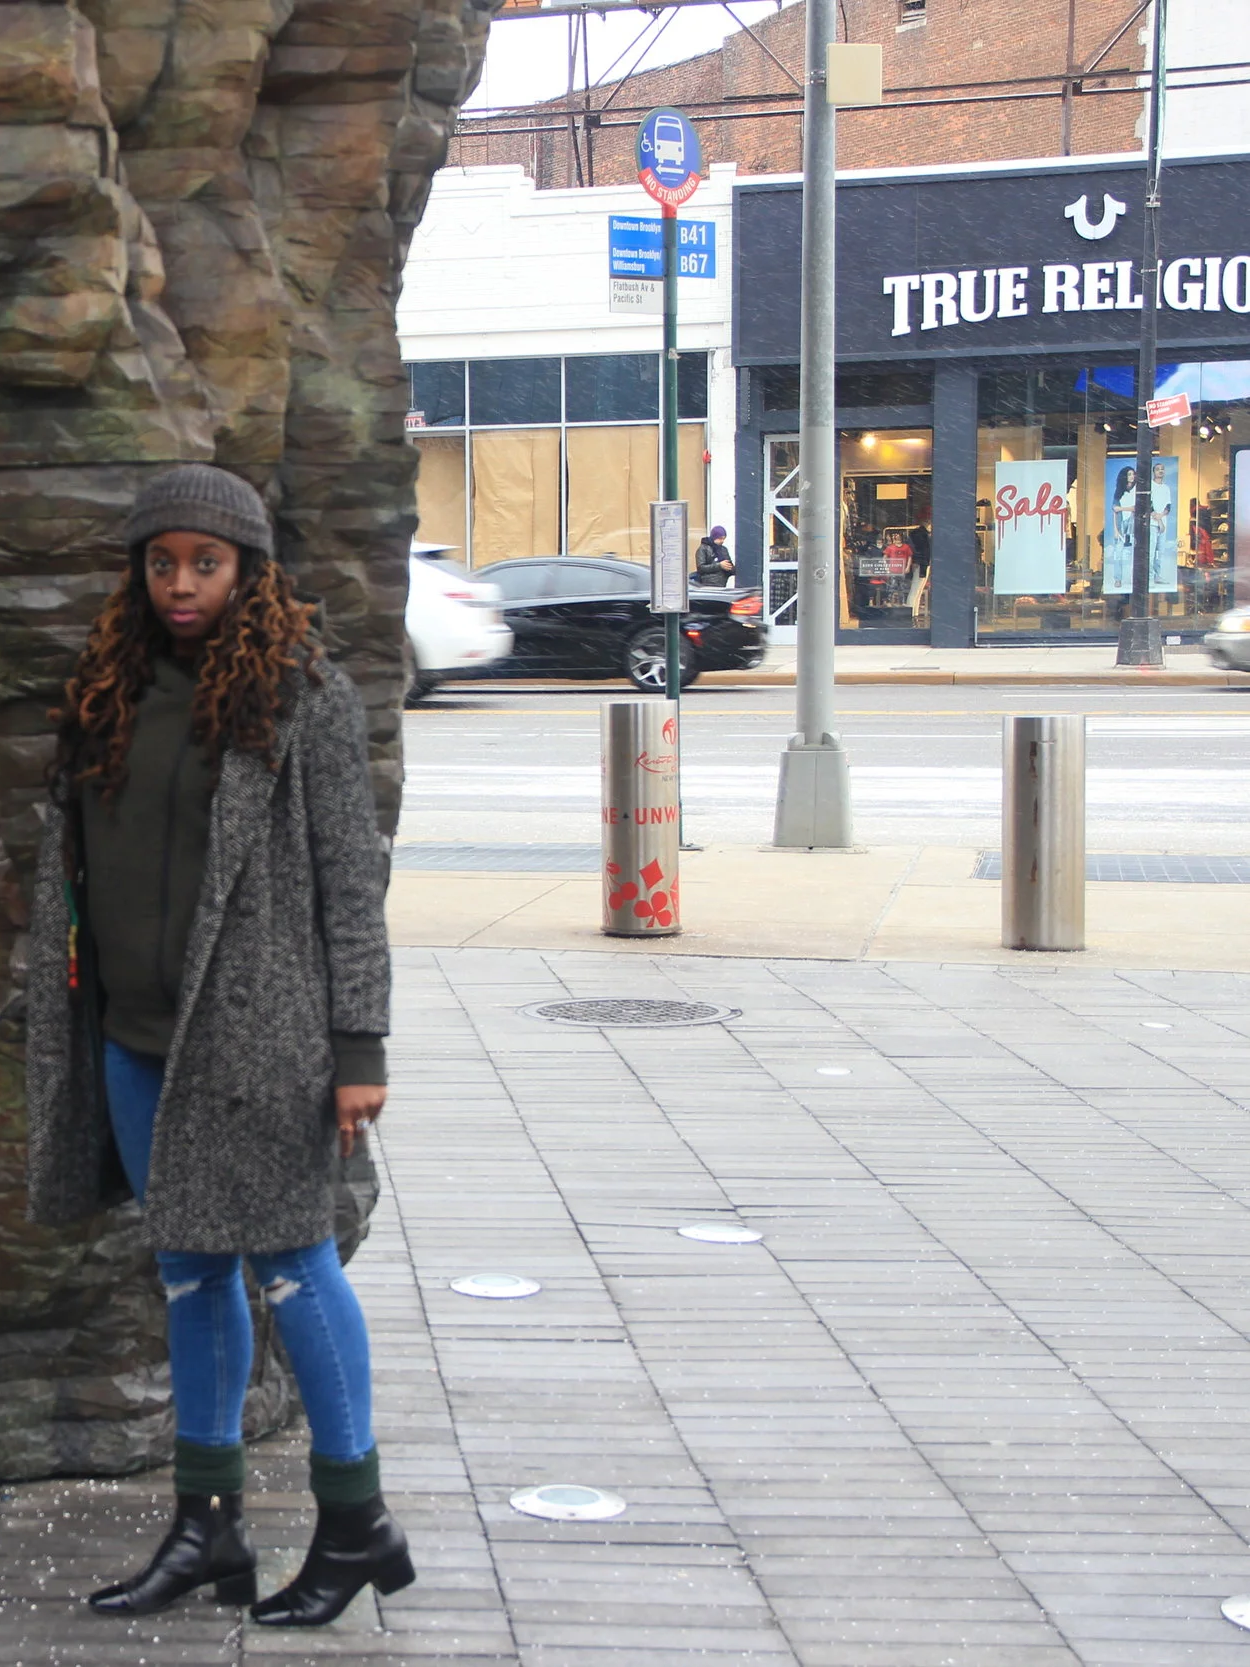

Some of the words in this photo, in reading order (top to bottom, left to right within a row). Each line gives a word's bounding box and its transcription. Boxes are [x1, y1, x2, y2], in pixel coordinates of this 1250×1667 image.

[645, 174, 657, 190] NO
[657, 177, 696, 202] STANDING
[612, 220, 639, 231] Downtown
[640, 222, 661, 234] Brooklyn
[680, 225, 706, 245] B41
[612, 248, 638, 258] Downtown
[680, 253, 708, 274] B67
[612, 260, 645, 273] Williamsburg
[613, 281, 639, 292] Flatbush
[641, 283, 649, 292] Av
[613, 293, 634, 303] Pacific
[636, 295, 643, 304] St
[883, 266, 1029, 337] TRUE
[1041, 255, 1250, 314] RELGIO
[995, 482, 1066, 527] Sale
